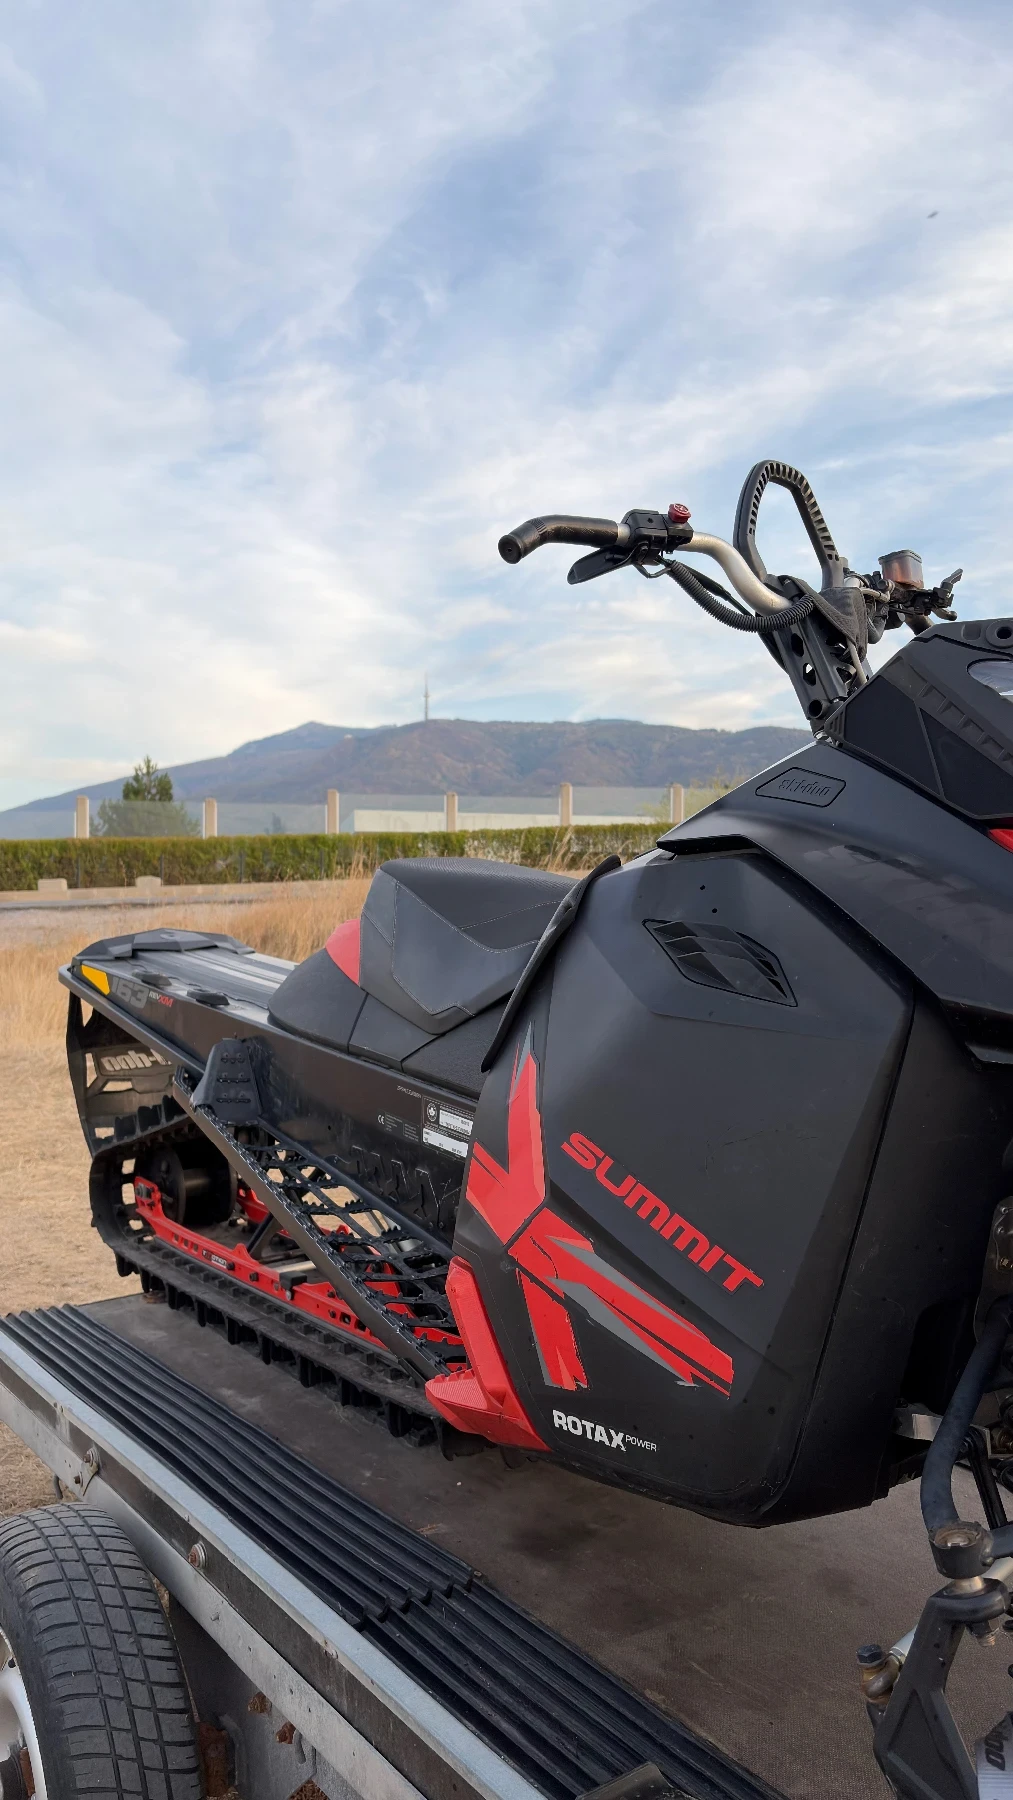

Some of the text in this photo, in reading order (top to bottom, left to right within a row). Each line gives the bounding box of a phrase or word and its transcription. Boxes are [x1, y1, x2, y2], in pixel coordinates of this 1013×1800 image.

[111, 976, 149, 1009] 163
[561, 1132, 764, 1292] SUMMIT
[552, 1409, 657, 1452] ROTAX POWER
